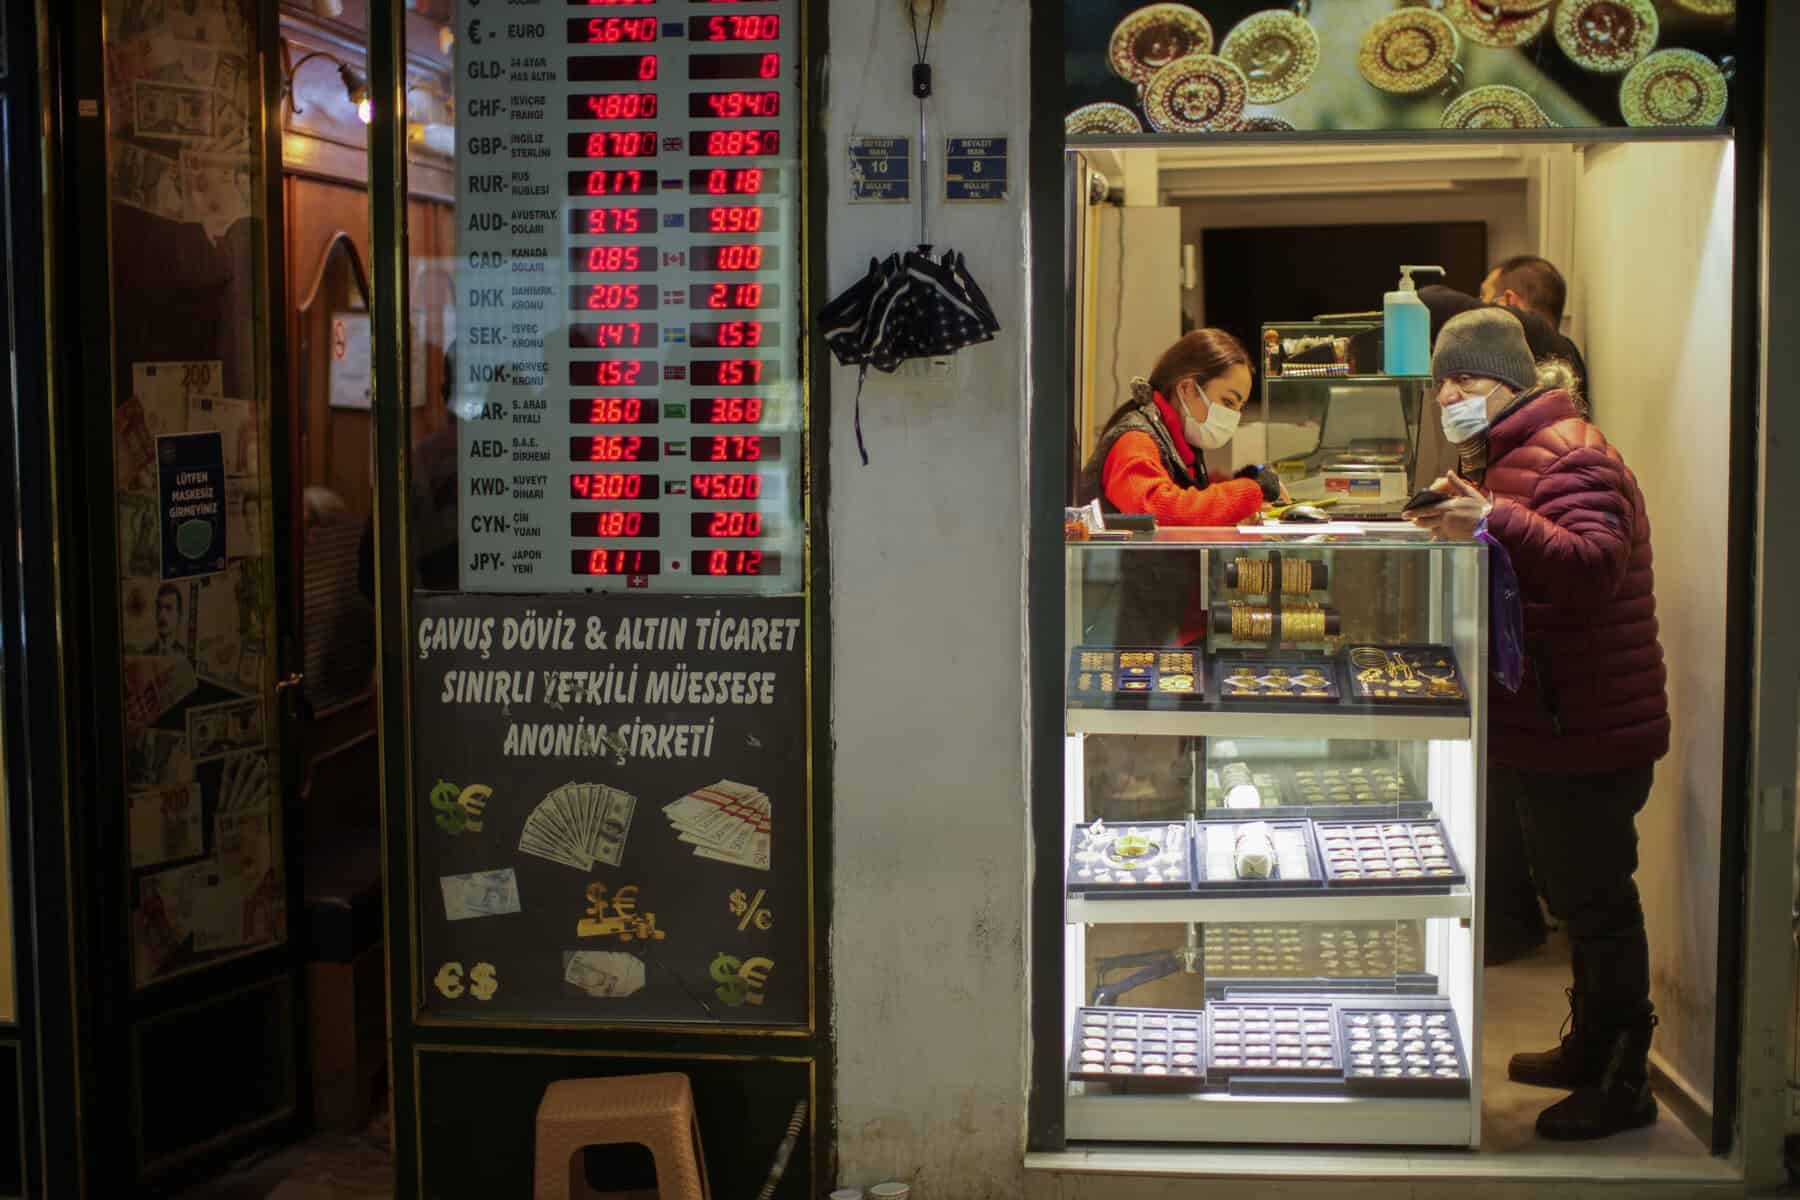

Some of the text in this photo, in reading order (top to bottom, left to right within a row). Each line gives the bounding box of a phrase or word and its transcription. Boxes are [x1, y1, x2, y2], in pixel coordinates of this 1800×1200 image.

[507, 24, 545, 38] EURO
[639, 56, 657, 81] 0
[760, 53, 780, 79] 0
[871, 159, 889, 174] 10
[972, 160, 983, 174] 8
[471, 402, 508, 420] AR-
[512, 549, 542, 560] JAPON
[417, 609, 801, 660] ÇAVUŞ DÖVİZ & ALTIN TİCARET
[441, 662, 777, 706] SINIRLI YETKİLİ MÜESSESE
[503, 715, 716, 766] ANONİM ŞİRKETİ
